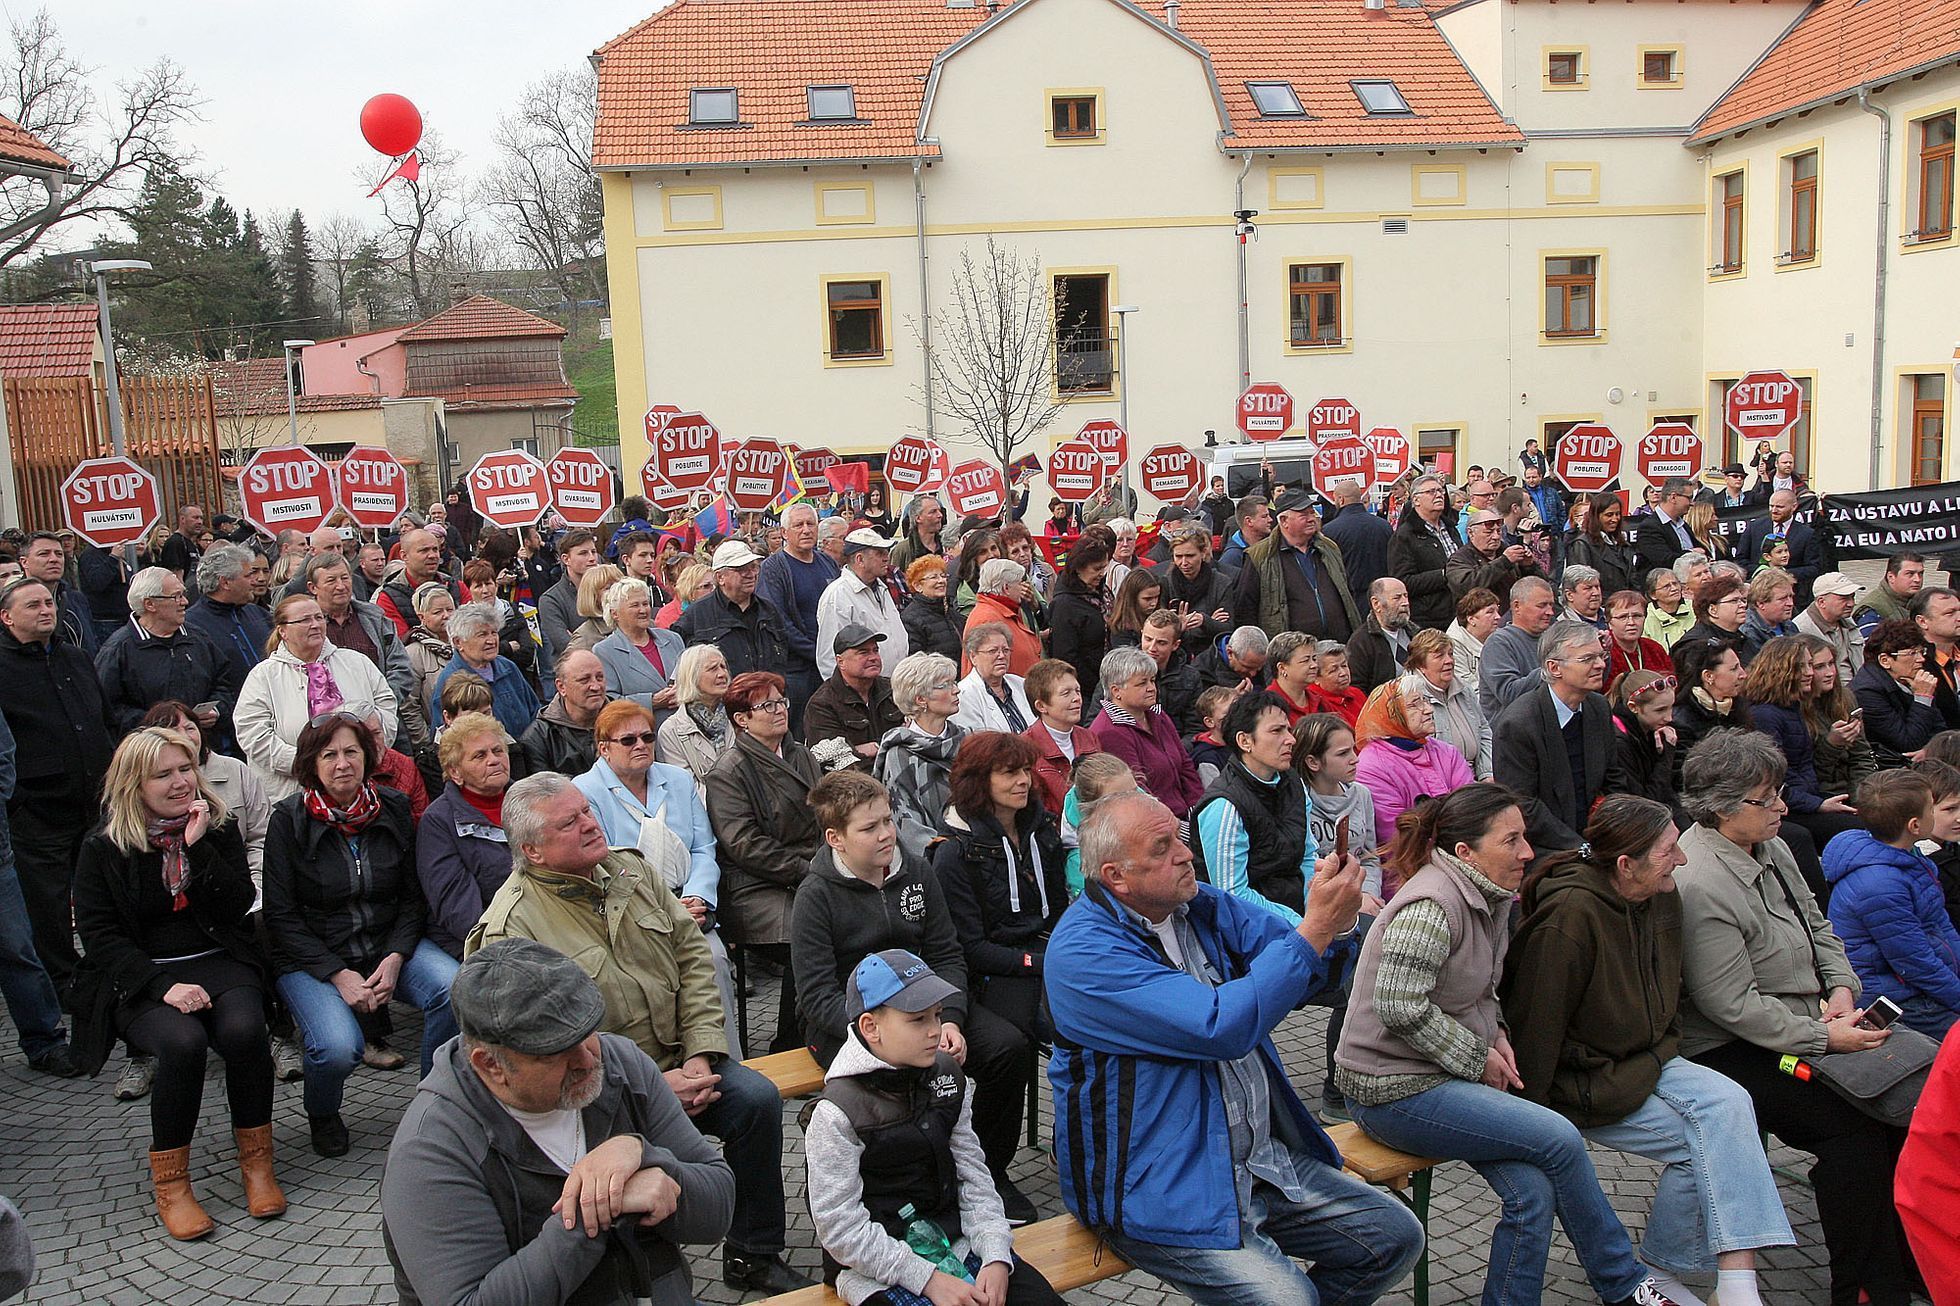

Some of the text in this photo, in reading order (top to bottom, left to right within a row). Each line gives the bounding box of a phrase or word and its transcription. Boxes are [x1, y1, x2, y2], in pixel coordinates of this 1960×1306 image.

[1243, 393, 1288, 412] STOP
[1734, 382, 1793, 406] STOP
[1312, 406, 1356, 425] STOP
[662, 425, 713, 452] STOP
[1080, 429, 1122, 448] STOP
[1365, 435, 1405, 455] STOP
[1564, 434, 1618, 457] STOP
[1643, 434, 1697, 456] STOP
[735, 449, 783, 474] STOP
[795, 455, 836, 474] STOP
[893, 443, 929, 466] STOP
[1053, 450, 1099, 472] STOP
[1145, 452, 1192, 474] STOP
[1318, 446, 1368, 471] STOP
[249, 460, 320, 494] STOP
[345, 459, 399, 487] STOP
[475, 463, 537, 491] STOP
[551, 460, 605, 487] STOP
[950, 466, 995, 495] STOP
[72, 472, 144, 504] STOP
[272, 502, 312, 515] MSTIVOSTI
[495, 497, 531, 507] MSTIVOSTI
[1828, 508, 1852, 522] ZA
[1854, 501, 1922, 521] ÚSTAVU
[1927, 499, 1941, 514] A
[90, 512, 136, 523] HULVÁTSTVÍ
[1833, 534, 1855, 548] ZA
[1858, 532, 1880, 546] EU
[1884, 531, 1898, 545] A
[1900, 526, 1947, 543] NATO
[908, 894, 922, 904] PRO
